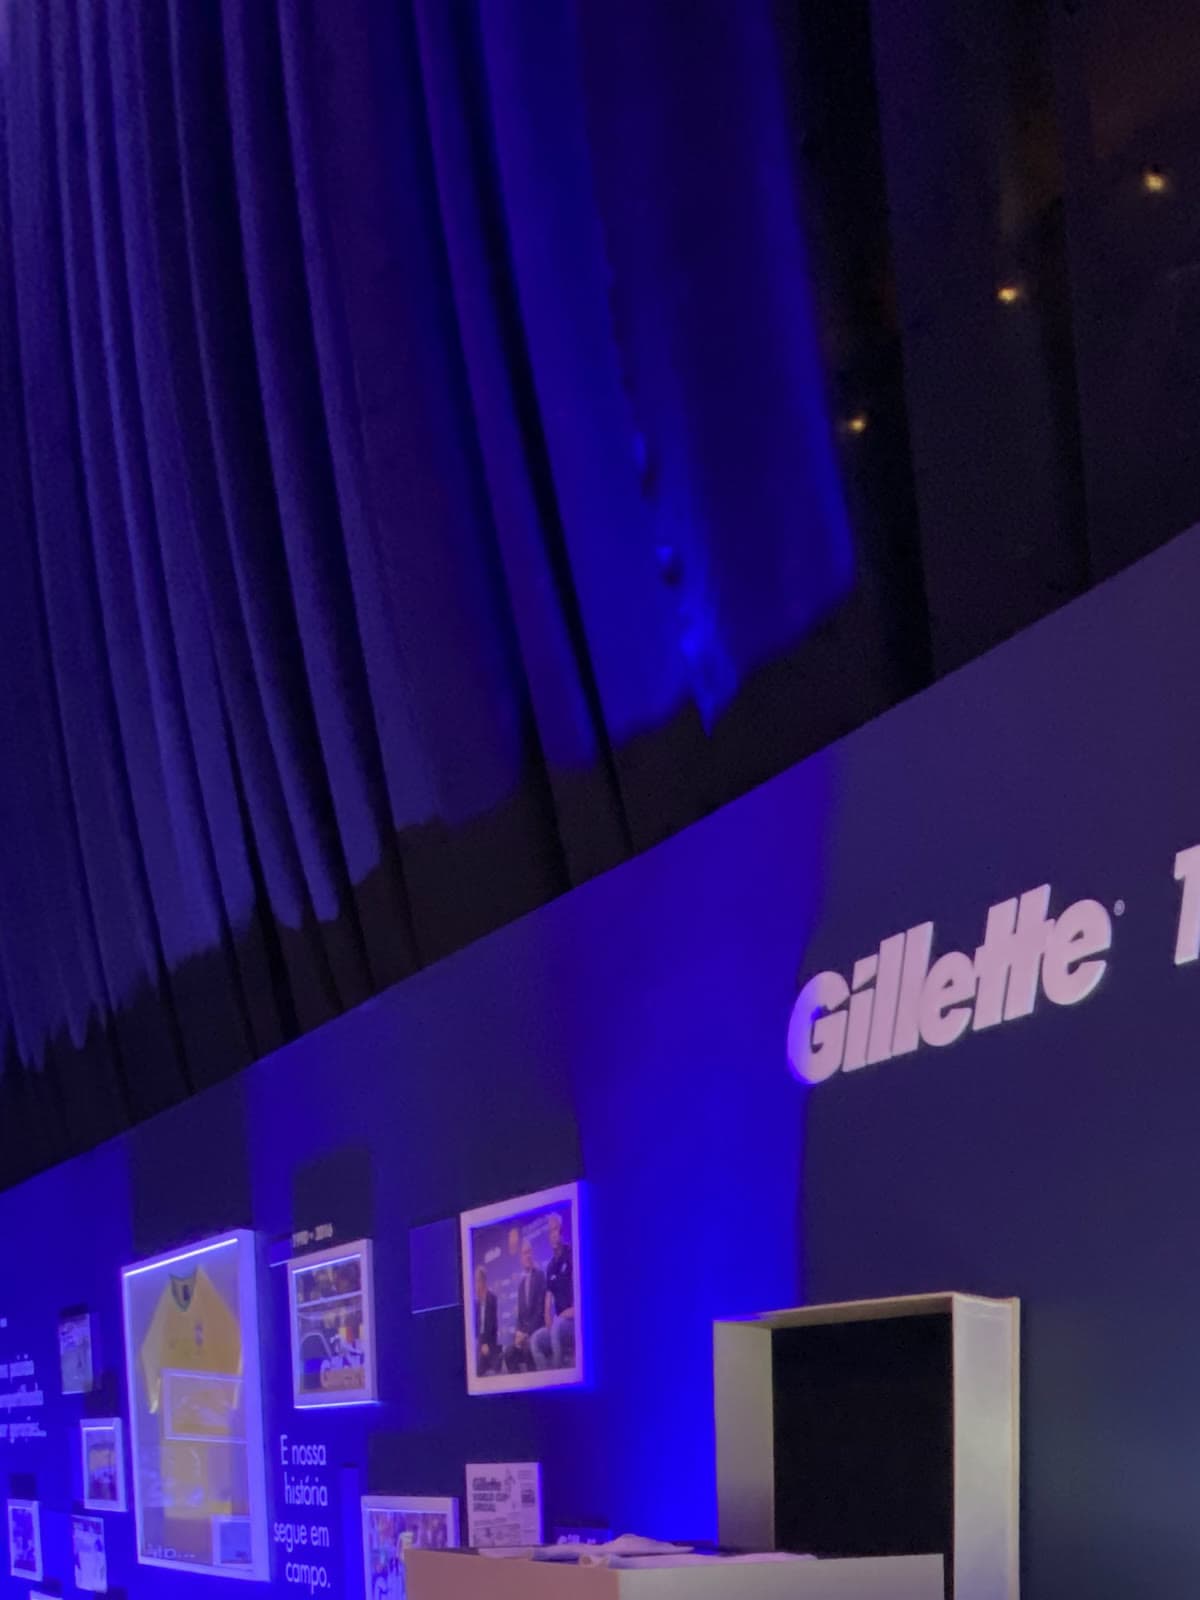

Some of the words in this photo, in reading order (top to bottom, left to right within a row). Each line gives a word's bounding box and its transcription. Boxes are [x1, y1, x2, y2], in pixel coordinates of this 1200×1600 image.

[291, 1444, 327, 1466] nossa
[284, 1471, 328, 1507] história
[273, 1521, 308, 1553] segue
[310, 1524, 330, 1548] em
[285, 1561, 331, 1595] campo.
